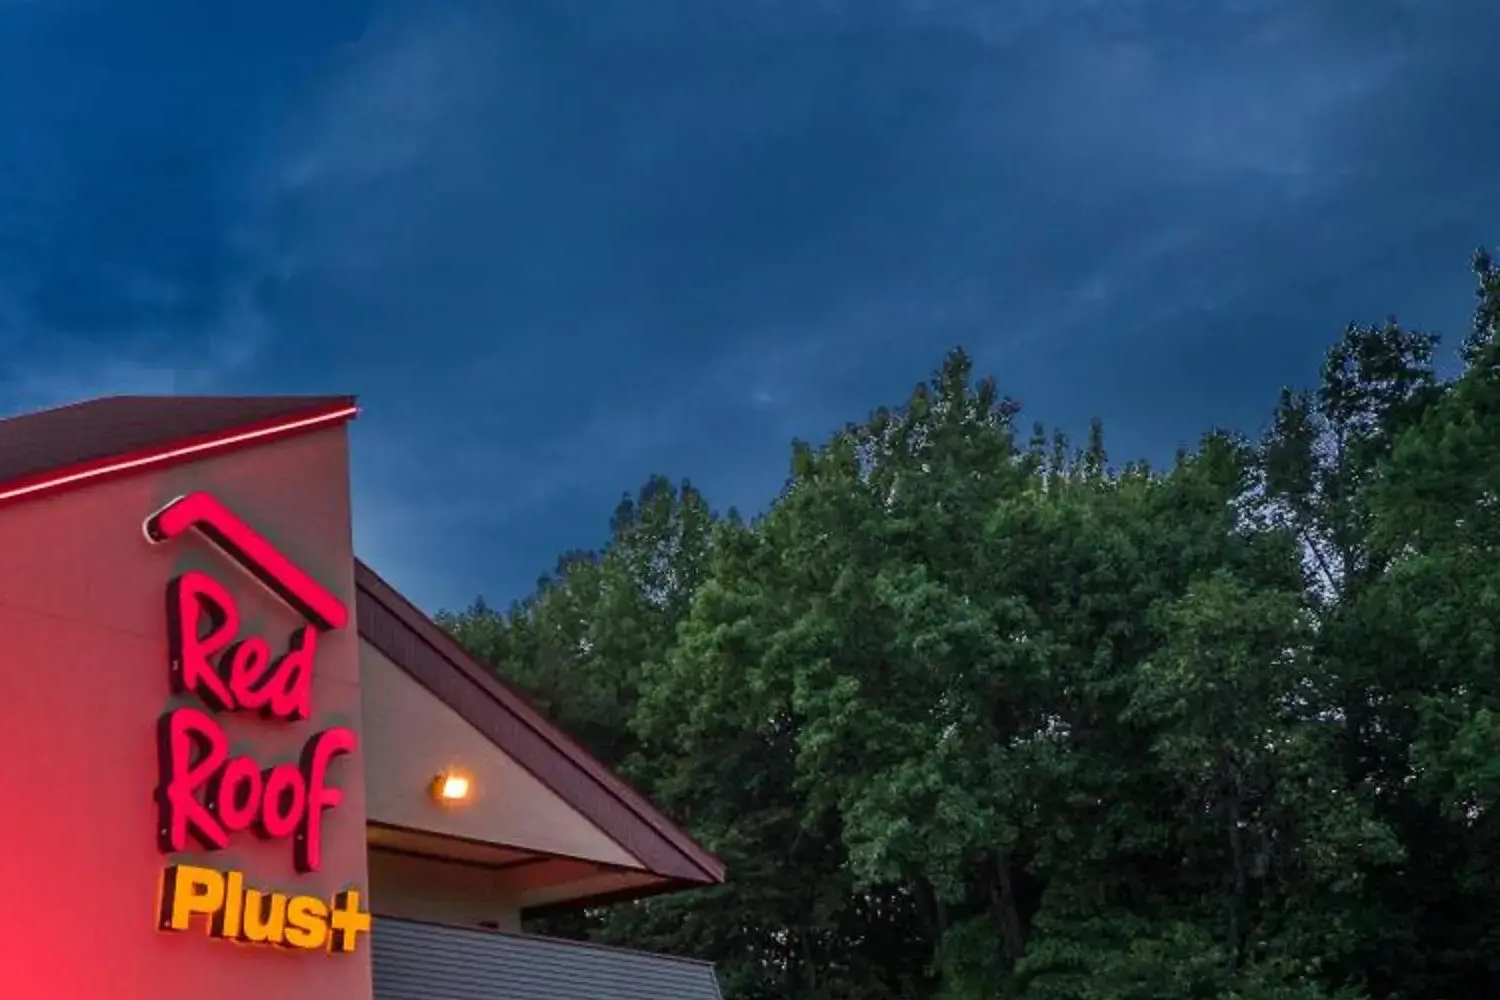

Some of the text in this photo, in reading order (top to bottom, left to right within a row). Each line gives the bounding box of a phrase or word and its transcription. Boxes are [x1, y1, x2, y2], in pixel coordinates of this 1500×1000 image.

[178, 571, 317, 719] Red
[167, 707, 357, 870] Roof
[171, 864, 371, 951] Plus+
